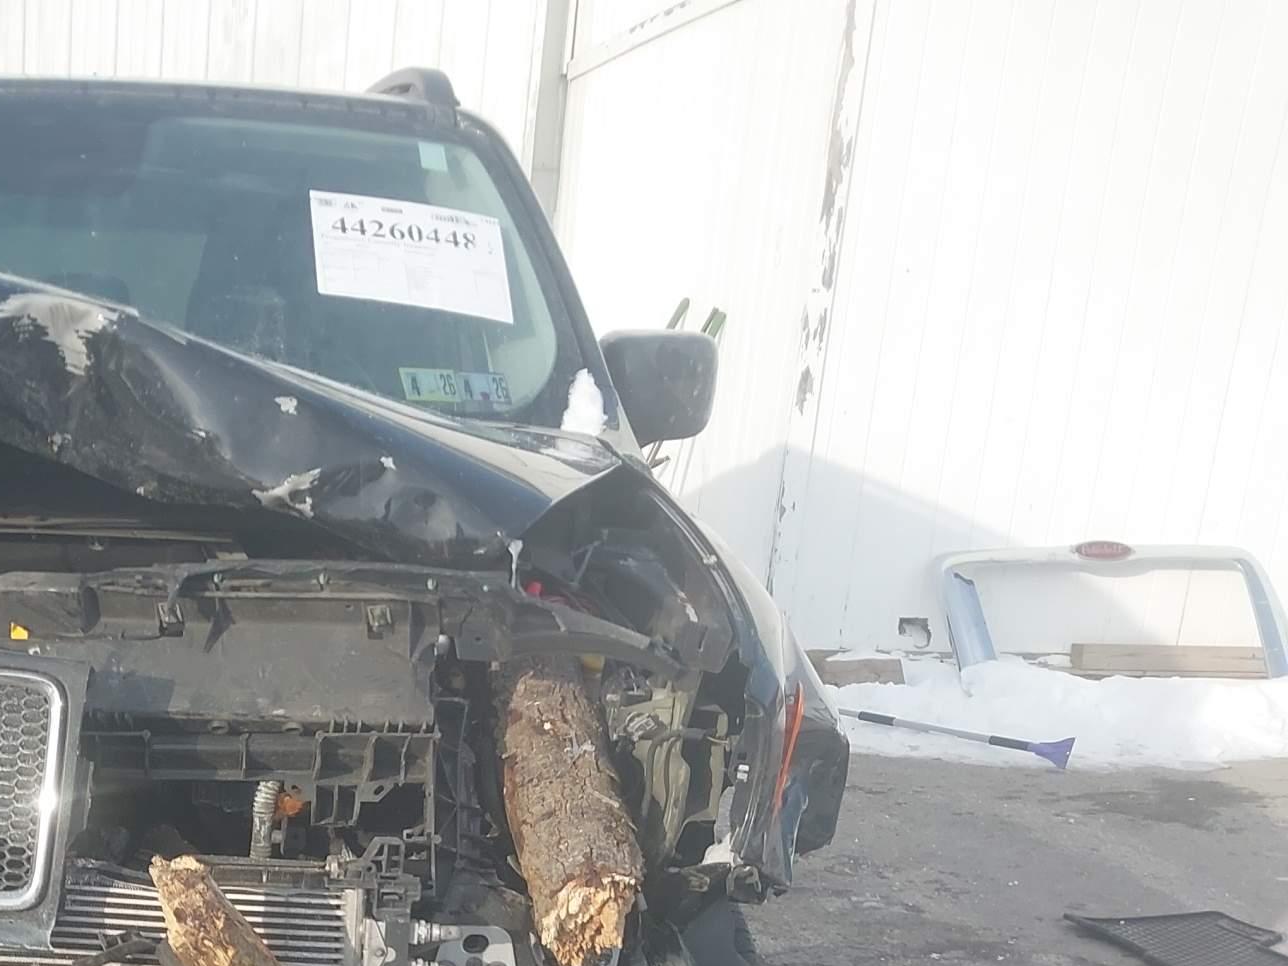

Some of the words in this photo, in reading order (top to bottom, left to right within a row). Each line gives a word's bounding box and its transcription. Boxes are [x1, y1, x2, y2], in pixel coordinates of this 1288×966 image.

[331, 216, 477, 250] 44260448
[439, 374, 457, 396] 26
[492, 376, 510, 400] 26
